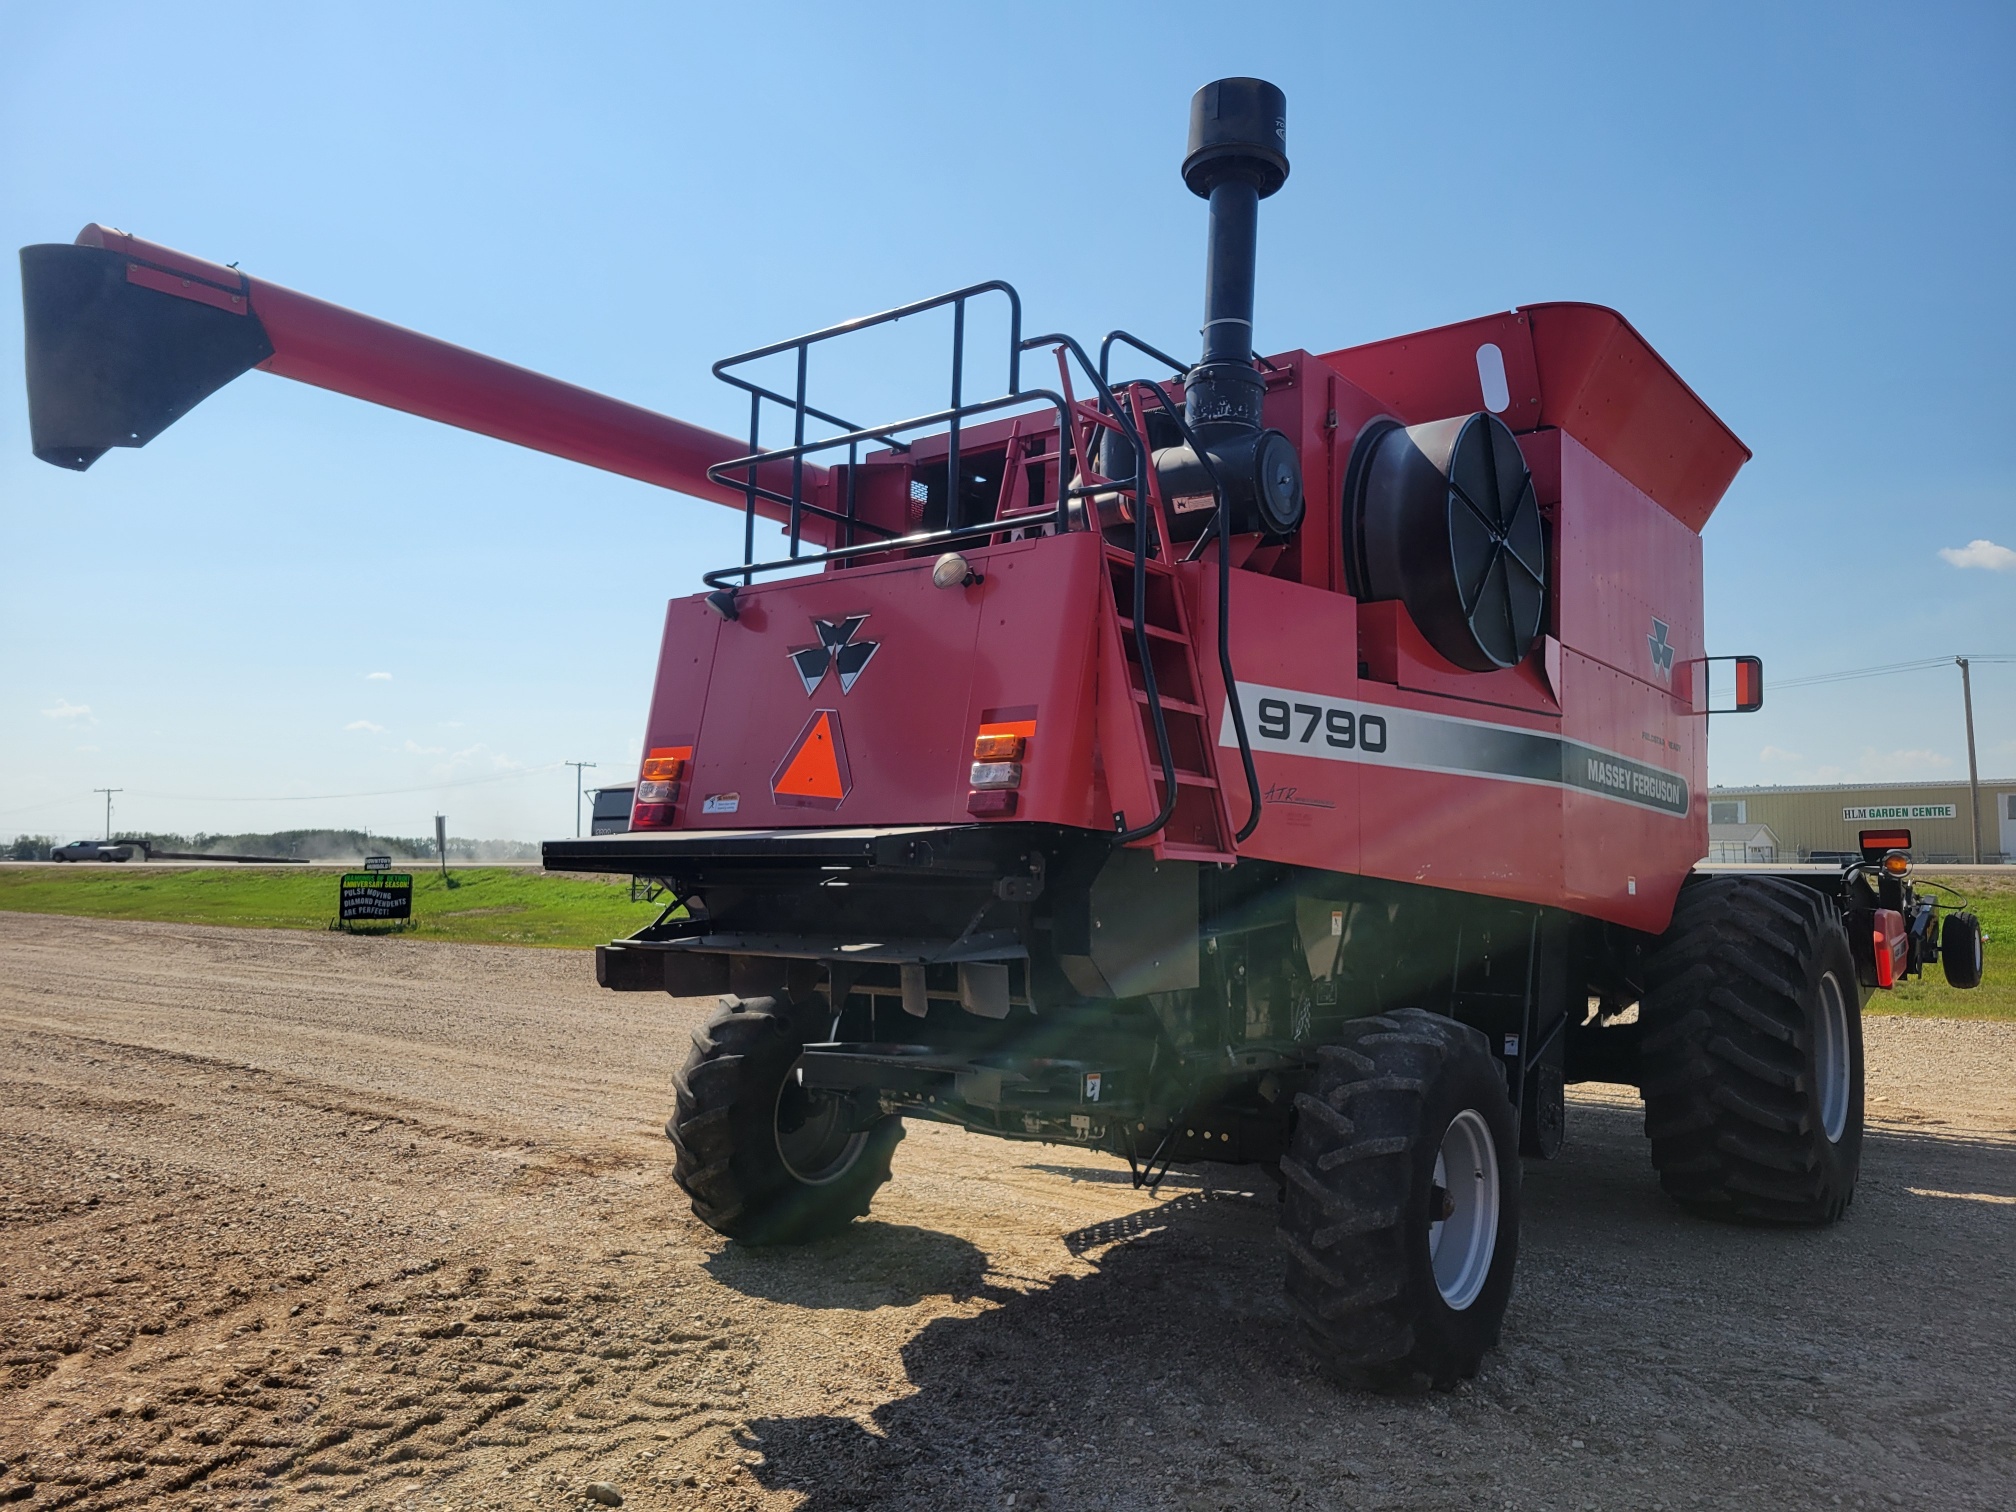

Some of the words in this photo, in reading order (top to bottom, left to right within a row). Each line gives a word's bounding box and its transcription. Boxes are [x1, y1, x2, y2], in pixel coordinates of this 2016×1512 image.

[1258, 698, 1387, 753] 9790
[1587, 758, 1631, 791] MASSEY
[1633, 771, 1680, 805] FERGUSON
[1264, 783, 1297, 801] ATR
[1843, 809, 1867, 819] HLM
[1868, 807, 1909, 818] GARDEN
[1912, 806, 1951, 817] CENTRE
[344, 888, 366, 897] PULSE
[367, 888, 391, 899] MOVING
[344, 897, 374, 907] DIAMOND
[374, 898, 407, 908] PENDENTS
[344, 908, 357, 917] ARE
[358, 907, 389, 915] PERFECT!
